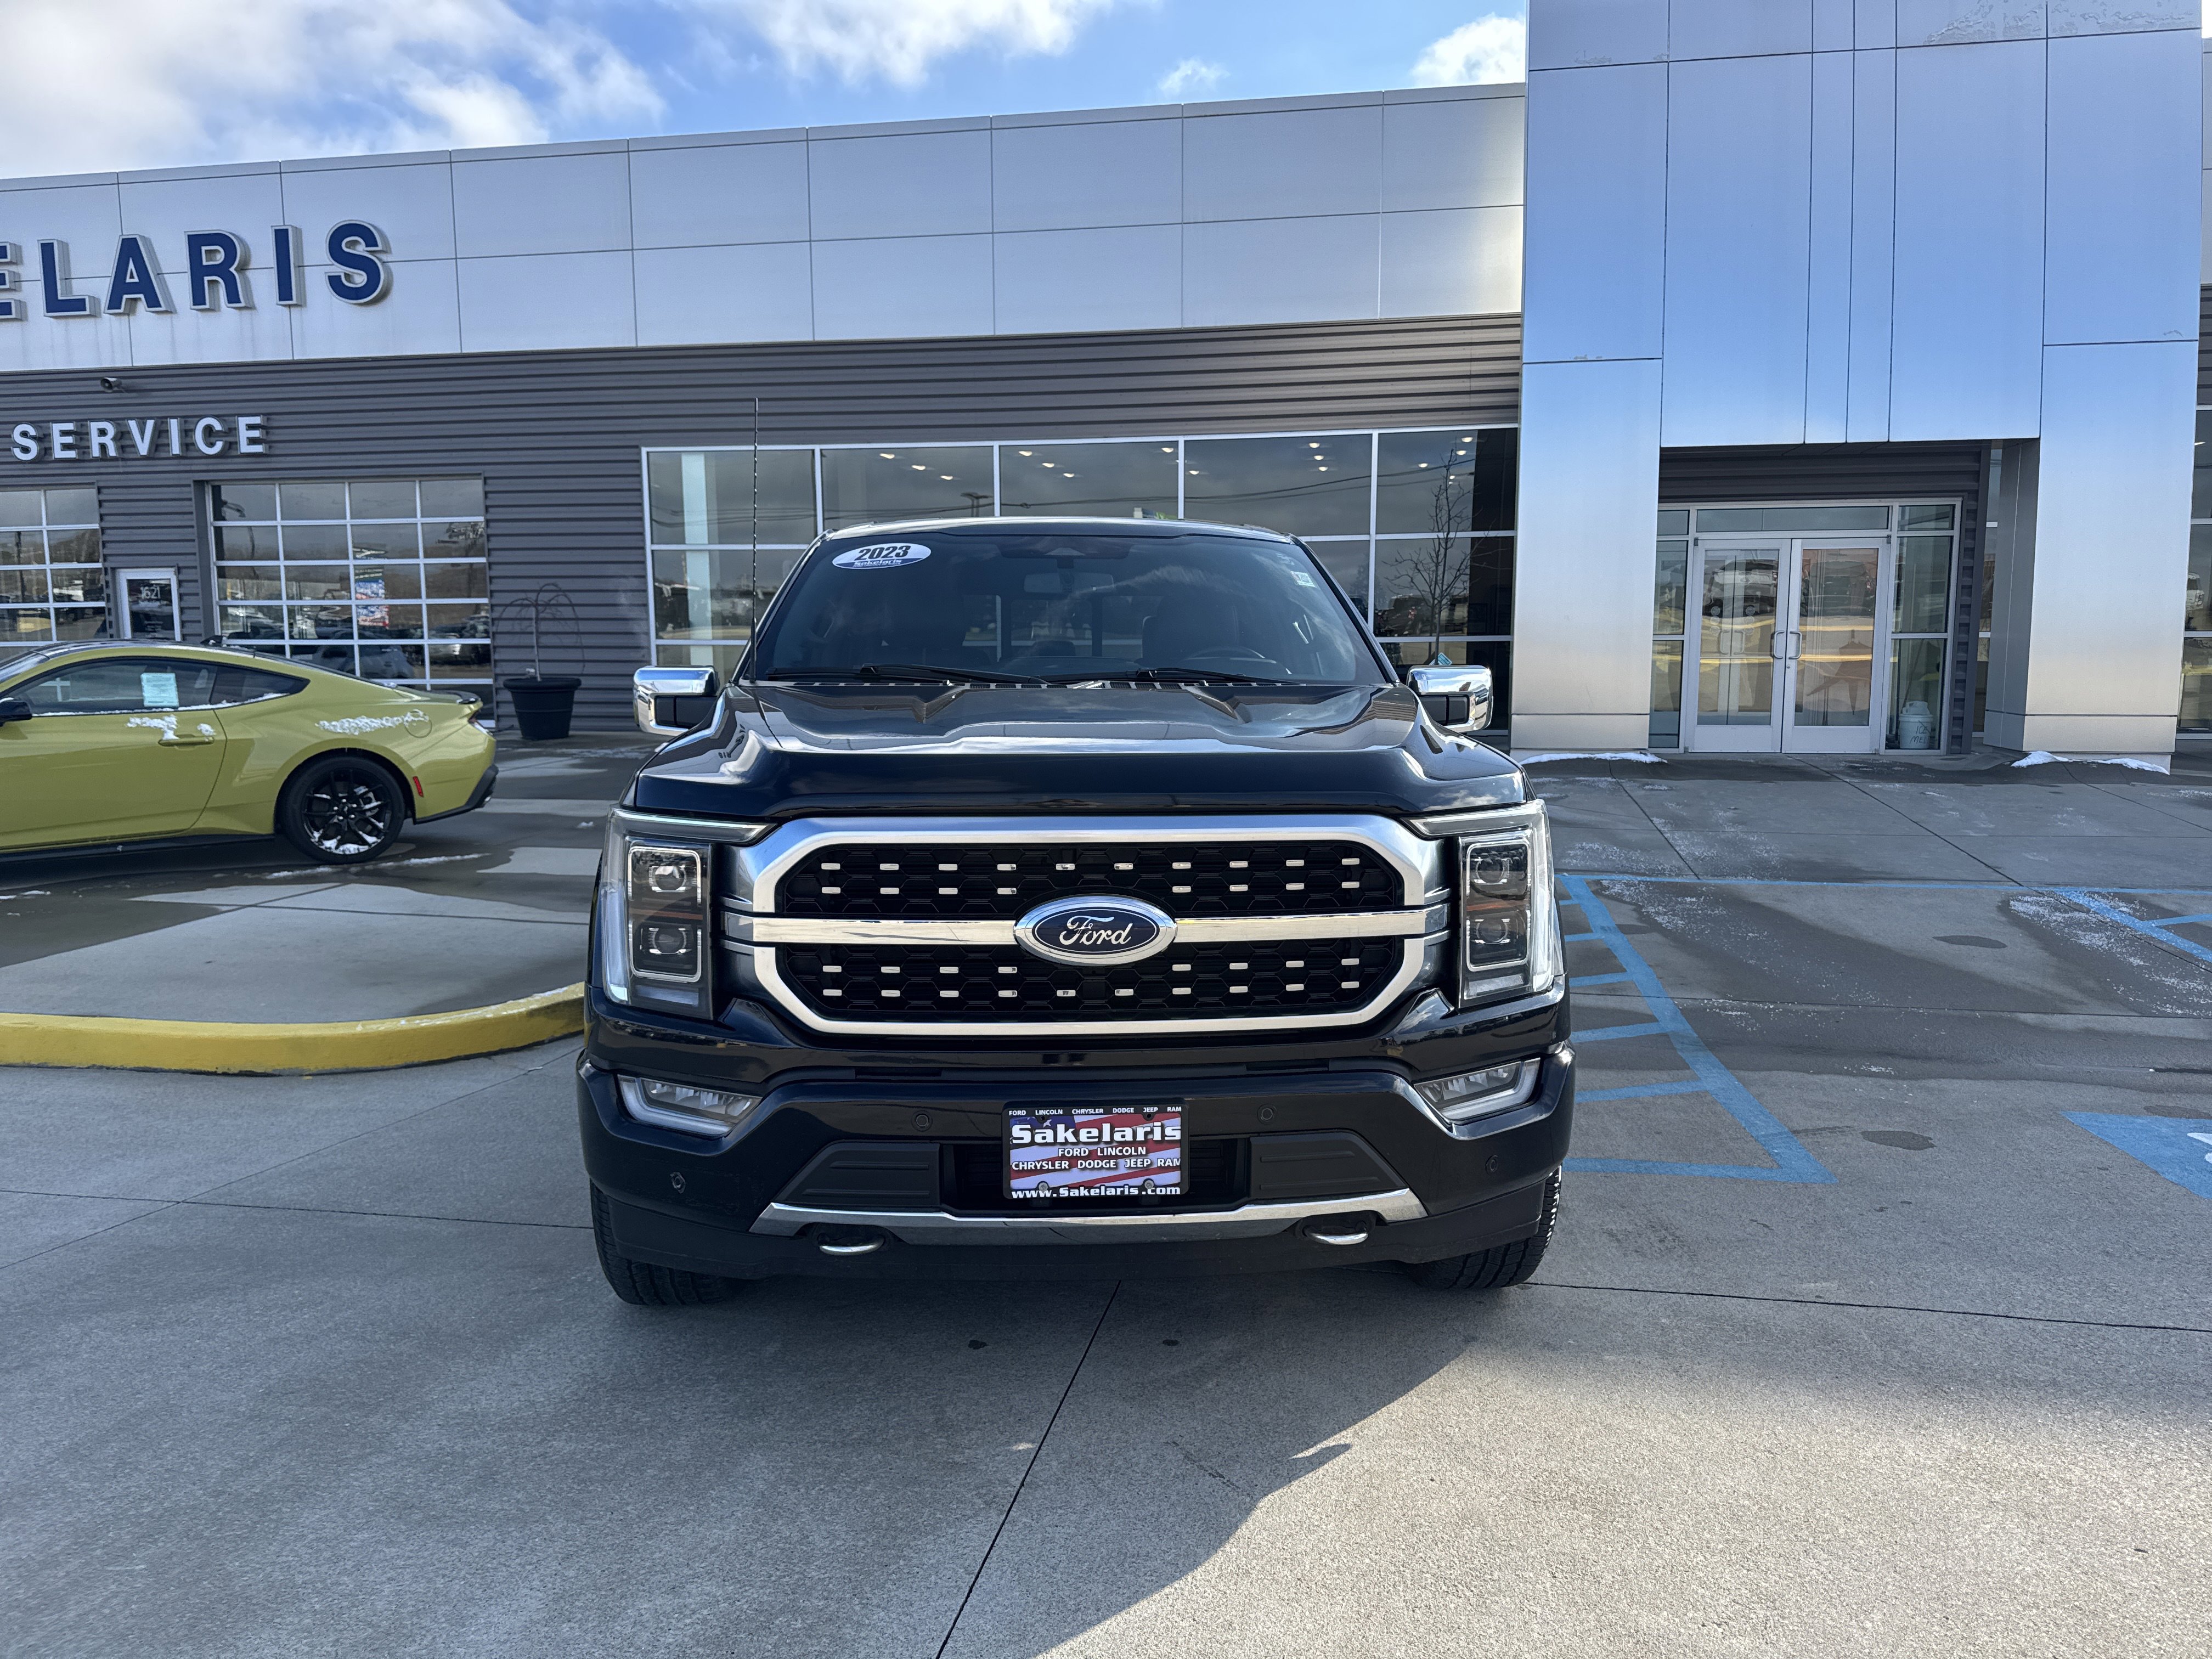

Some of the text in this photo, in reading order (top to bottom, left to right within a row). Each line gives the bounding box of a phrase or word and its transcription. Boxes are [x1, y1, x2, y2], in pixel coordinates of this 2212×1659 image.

[0, 219, 391, 320] LARIS
[11, 415, 266, 461] SERVICE
[854, 545, 911, 561] 2023
[140, 586, 161, 599] 1621
[1915, 725, 1927, 735] ICE
[1059, 915, 1133, 945] Ford
[1012, 1121, 1181, 1144] Sakelaris
[1058, 1146, 1146, 1157] FORD LINCOLN
[1012, 1160, 1069, 1170] CHRYSLER
[1077, 1159, 1116, 1169] DODGE
[1125, 1158, 1151, 1167] JEEP
